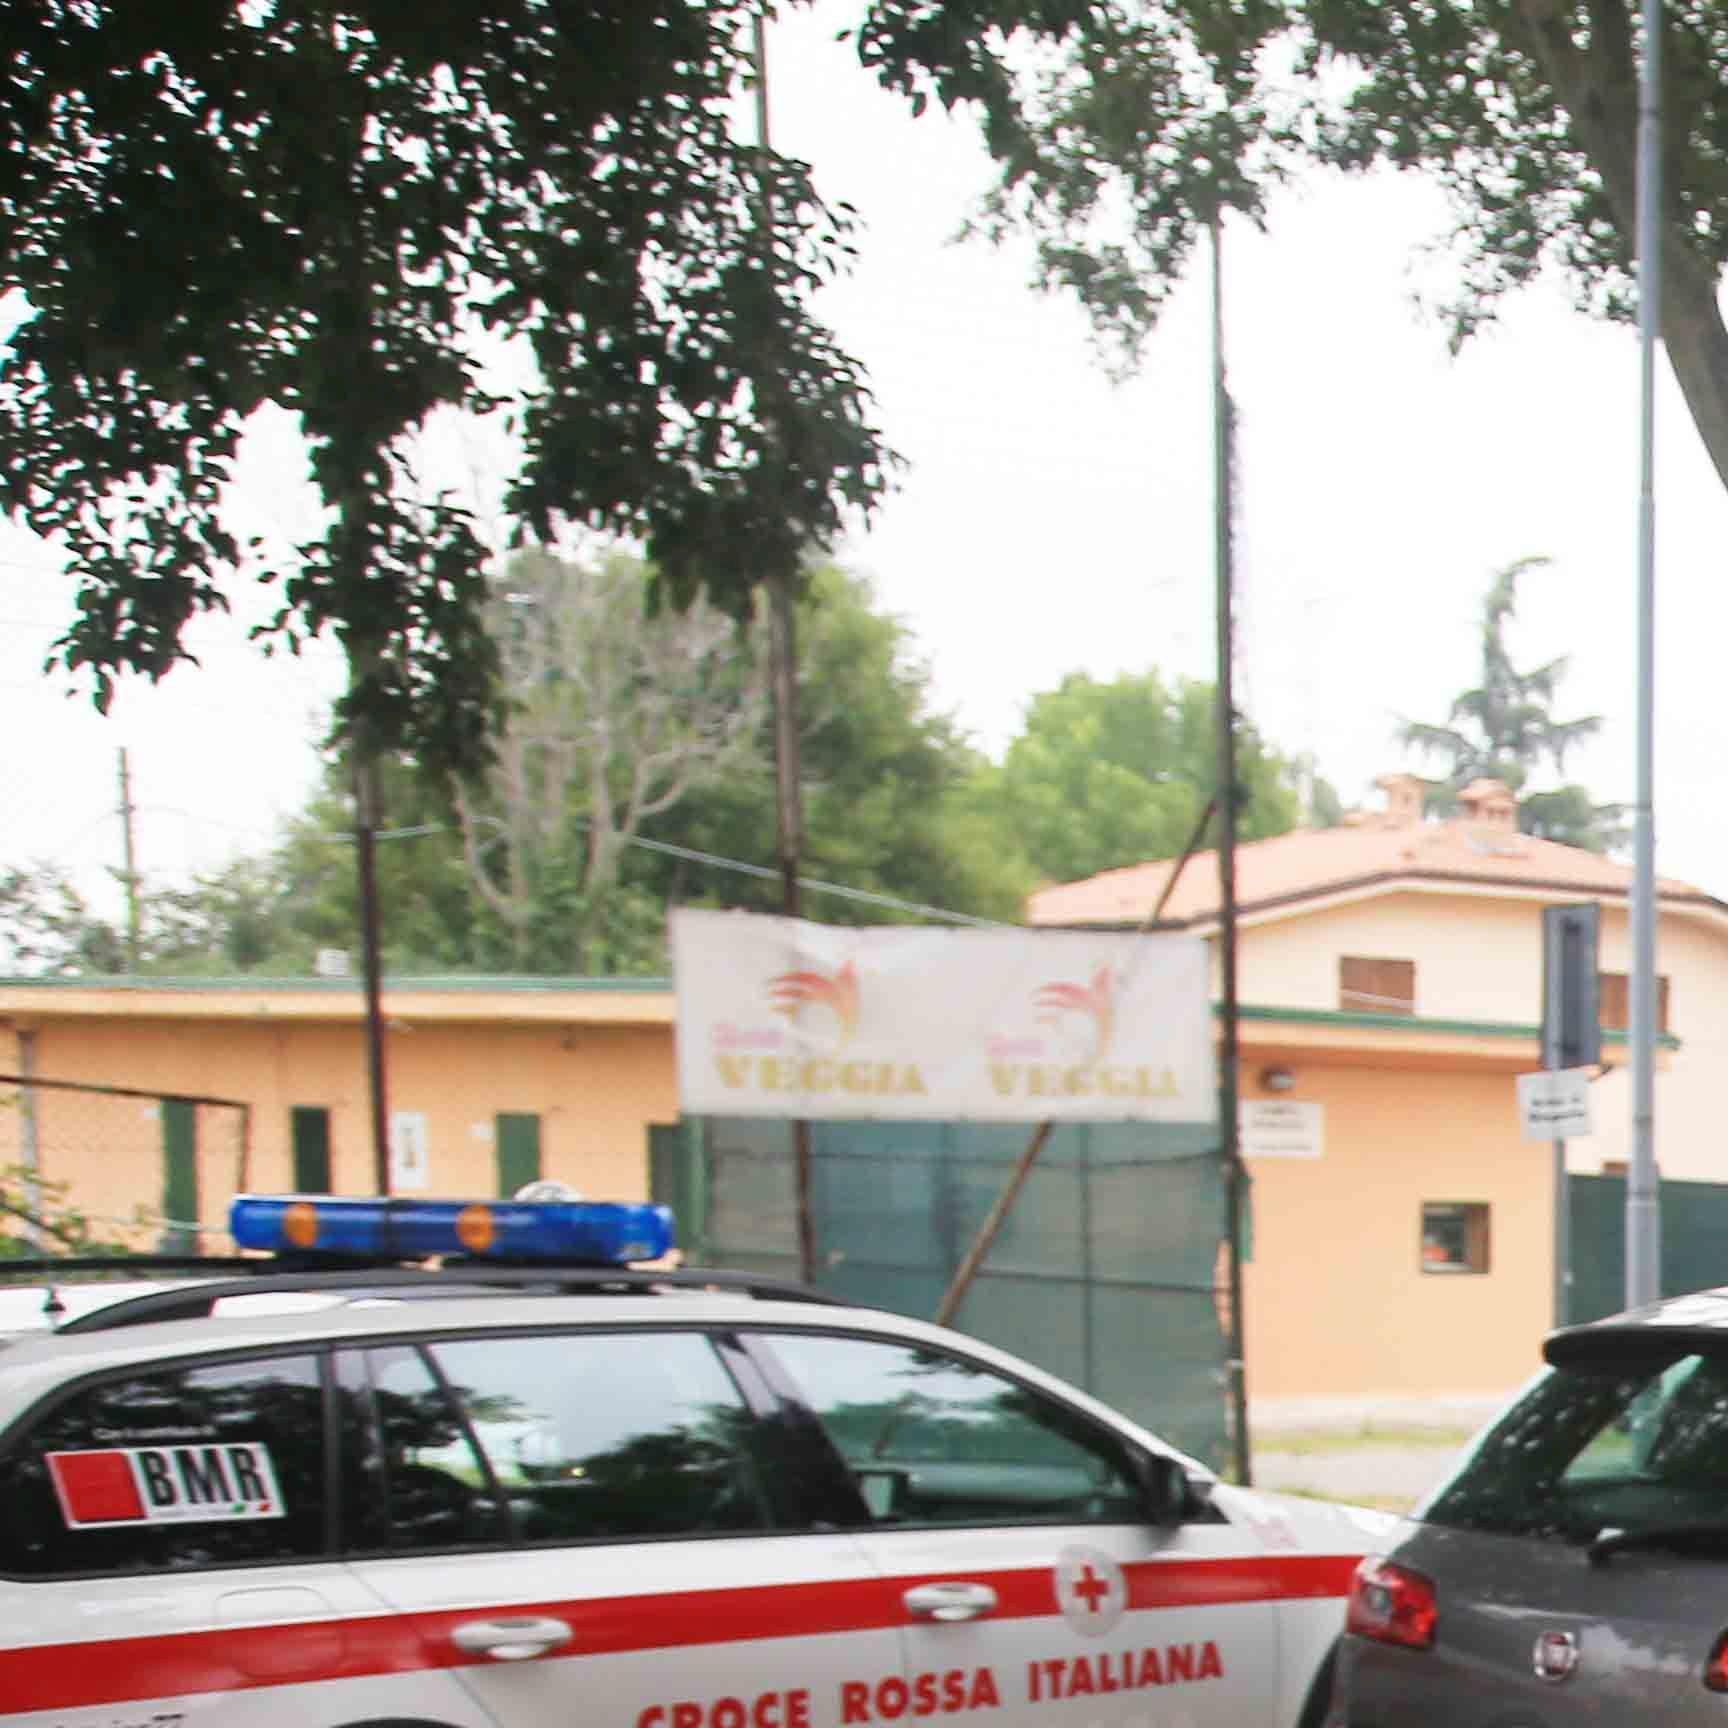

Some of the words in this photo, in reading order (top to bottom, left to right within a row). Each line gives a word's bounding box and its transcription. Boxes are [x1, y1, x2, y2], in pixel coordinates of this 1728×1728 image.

[712, 1055, 930, 1096] VEGGIA
[985, 1062, 1181, 1099] VEGGIA
[136, 1447, 269, 1506] BMR
[840, 1667, 999, 1725] ROSSA
[1027, 1640, 1224, 1702] ITALIANA
